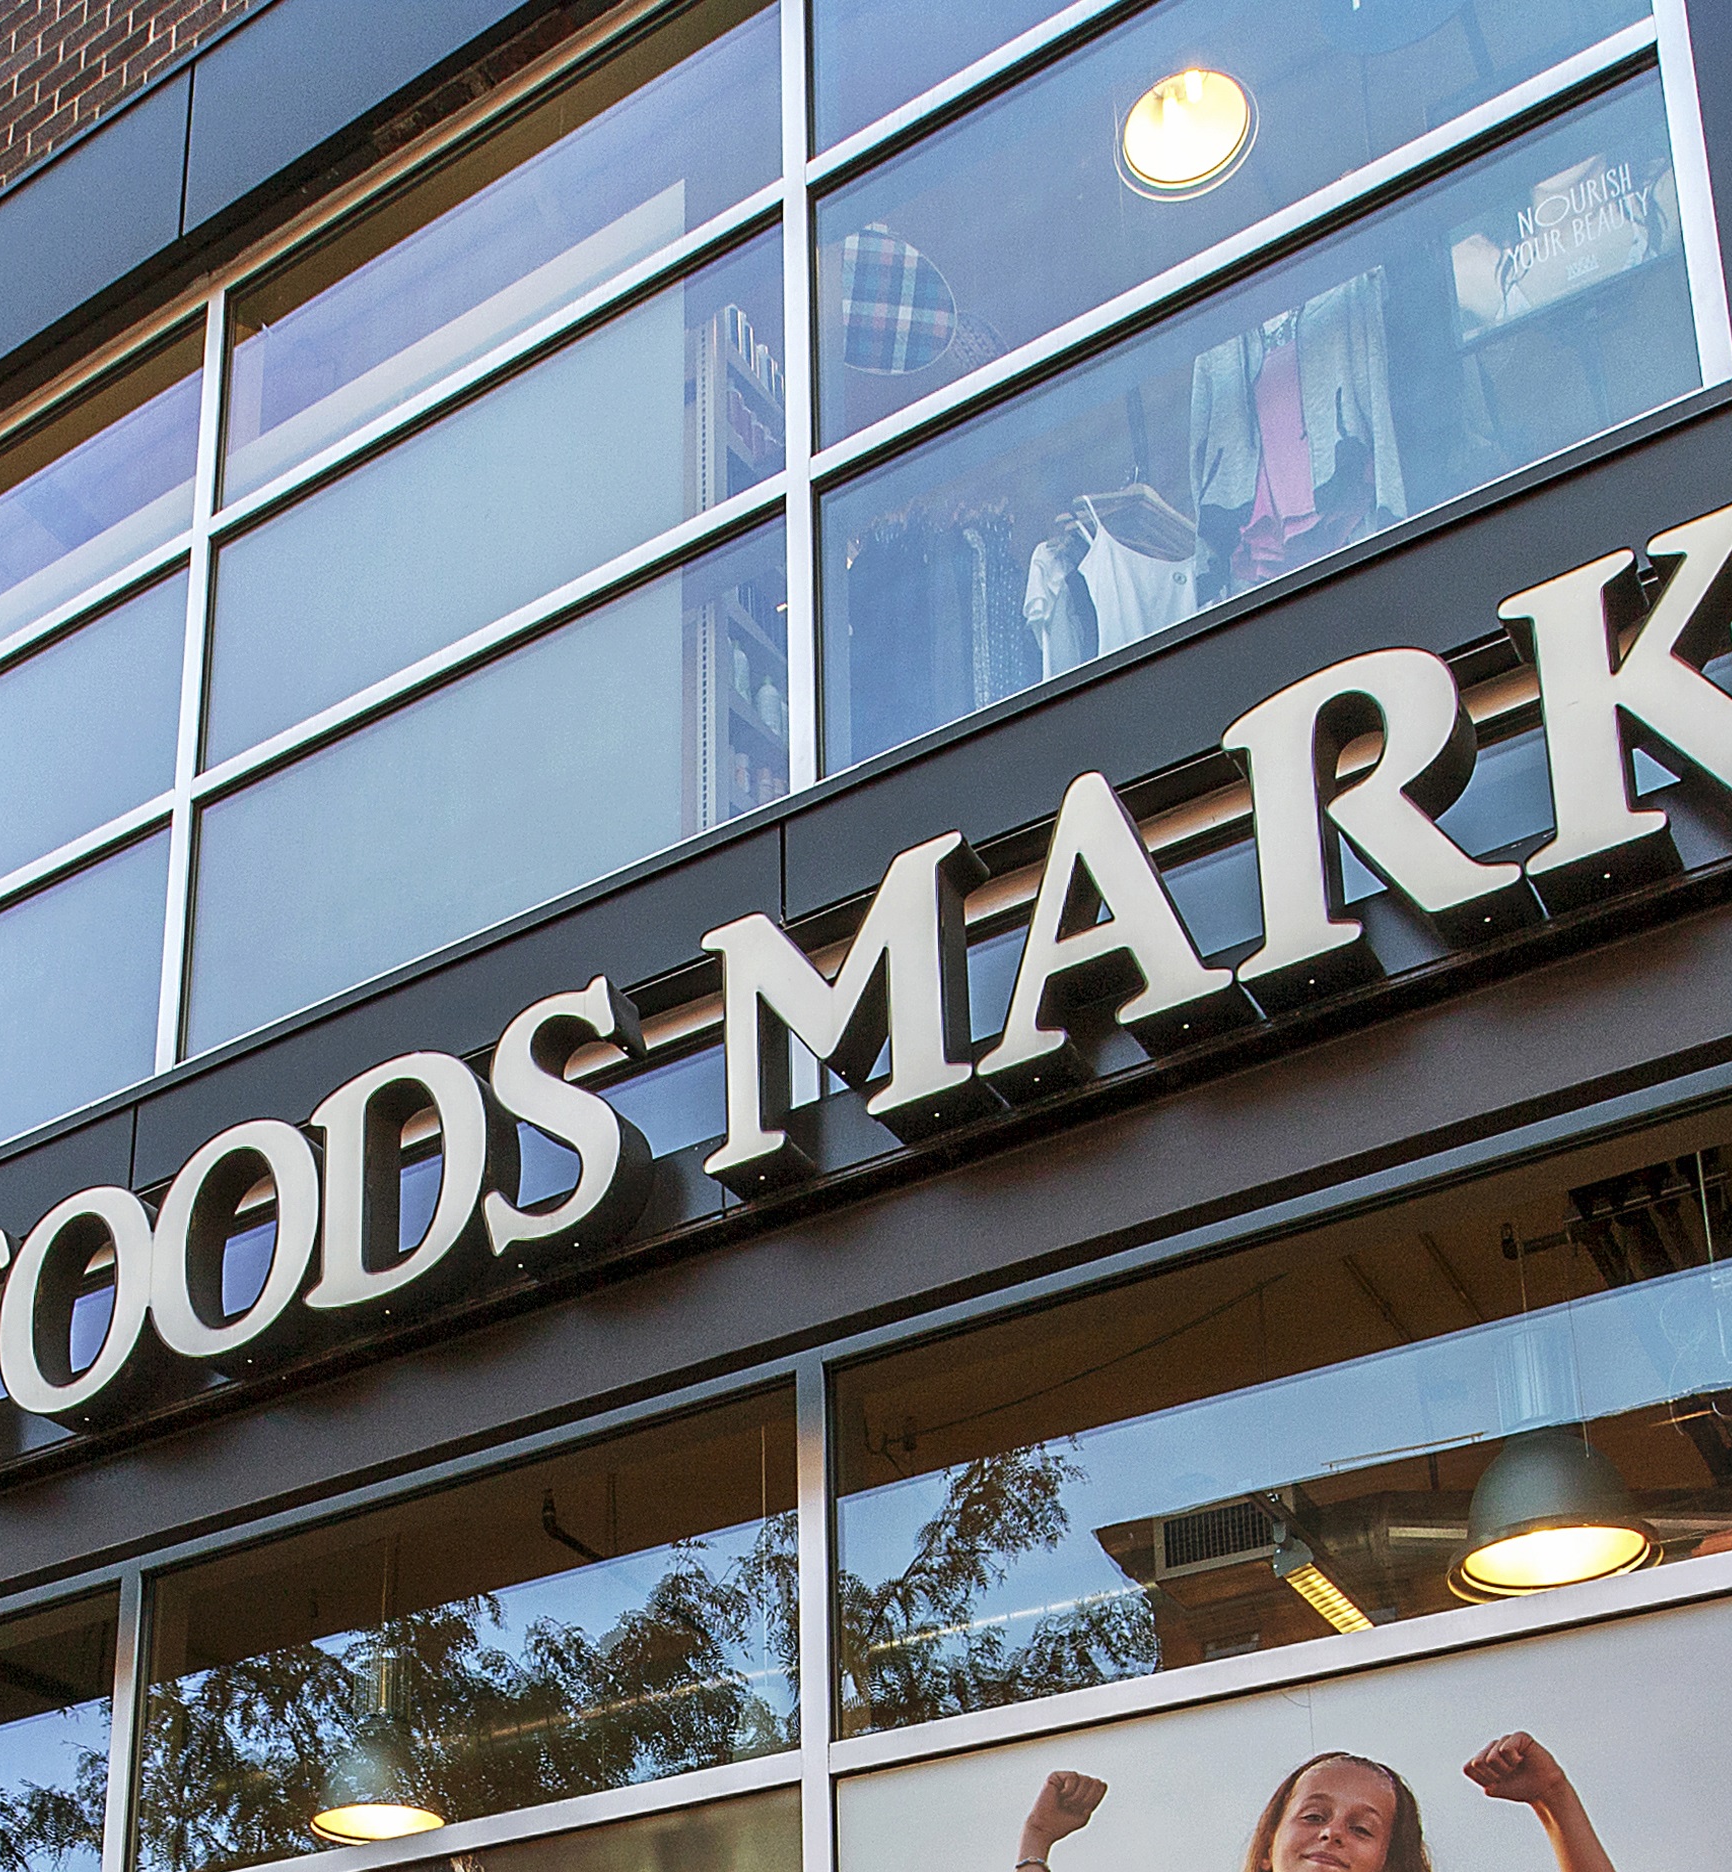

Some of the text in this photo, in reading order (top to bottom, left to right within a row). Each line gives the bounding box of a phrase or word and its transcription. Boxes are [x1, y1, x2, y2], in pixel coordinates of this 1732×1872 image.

[1507, 229, 1566, 274] YOUR
[1571, 186, 1651, 249] BEAUTY
[1517, 163, 1632, 239] NOURISH
